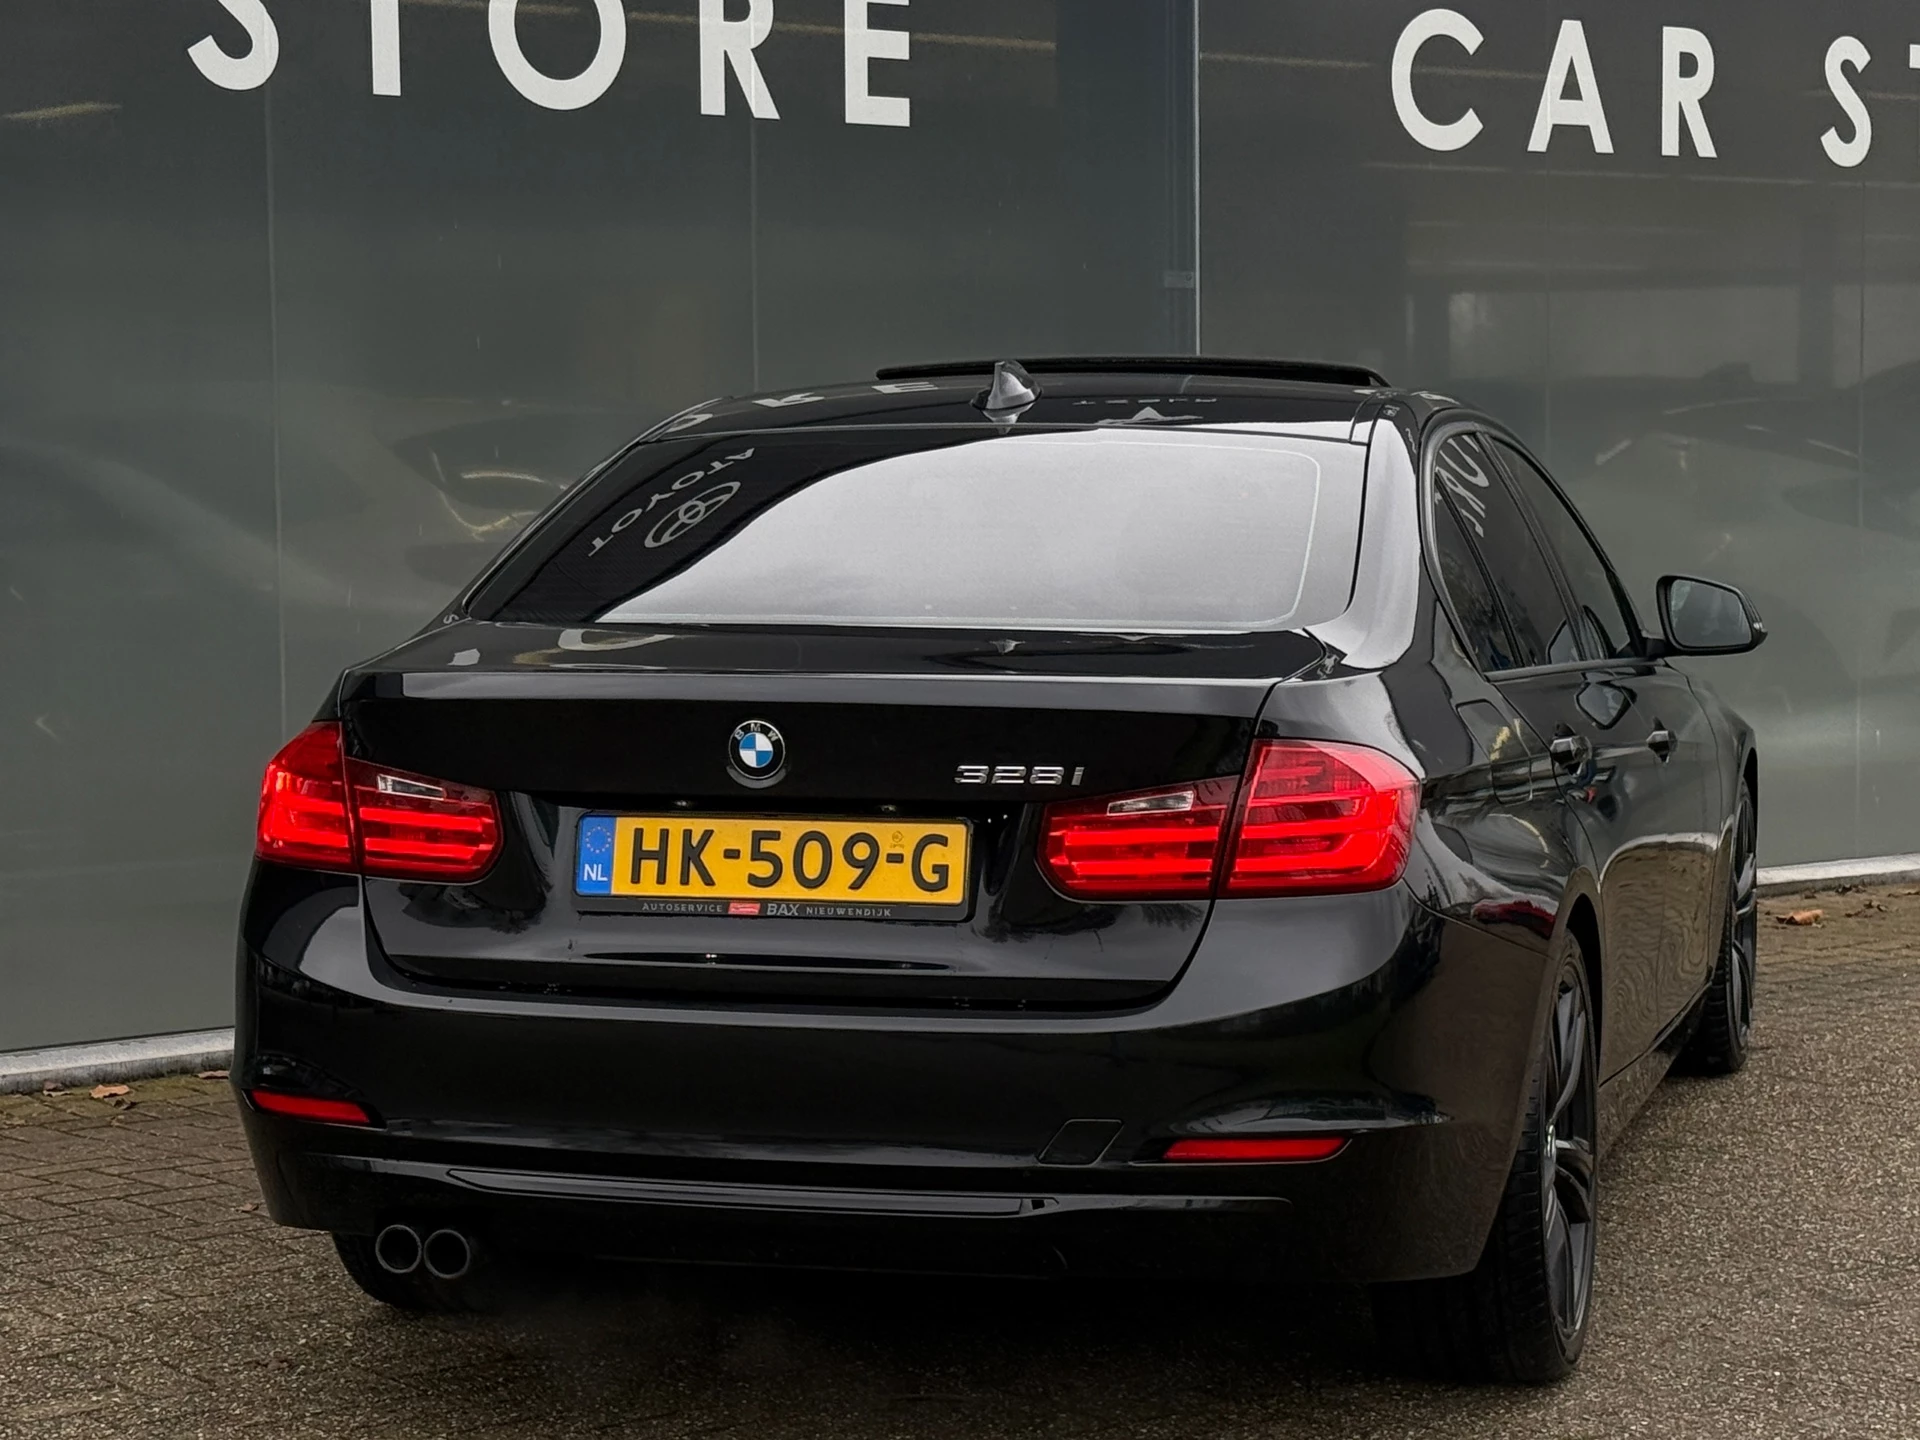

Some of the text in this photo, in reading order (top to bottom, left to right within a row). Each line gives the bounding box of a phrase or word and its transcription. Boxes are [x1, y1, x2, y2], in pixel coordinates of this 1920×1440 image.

[187, 0, 911, 127] STORE
[1391, 8, 1920, 167] CAR S
[734, 723, 779, 741] BMW
[954, 765, 1085, 786] 328i
[630, 827, 949, 892] HK-509-G
[583, 863, 608, 881] NL
[641, 902, 892, 917] AUTOSERVICE BAX NIEUWENDIJK
